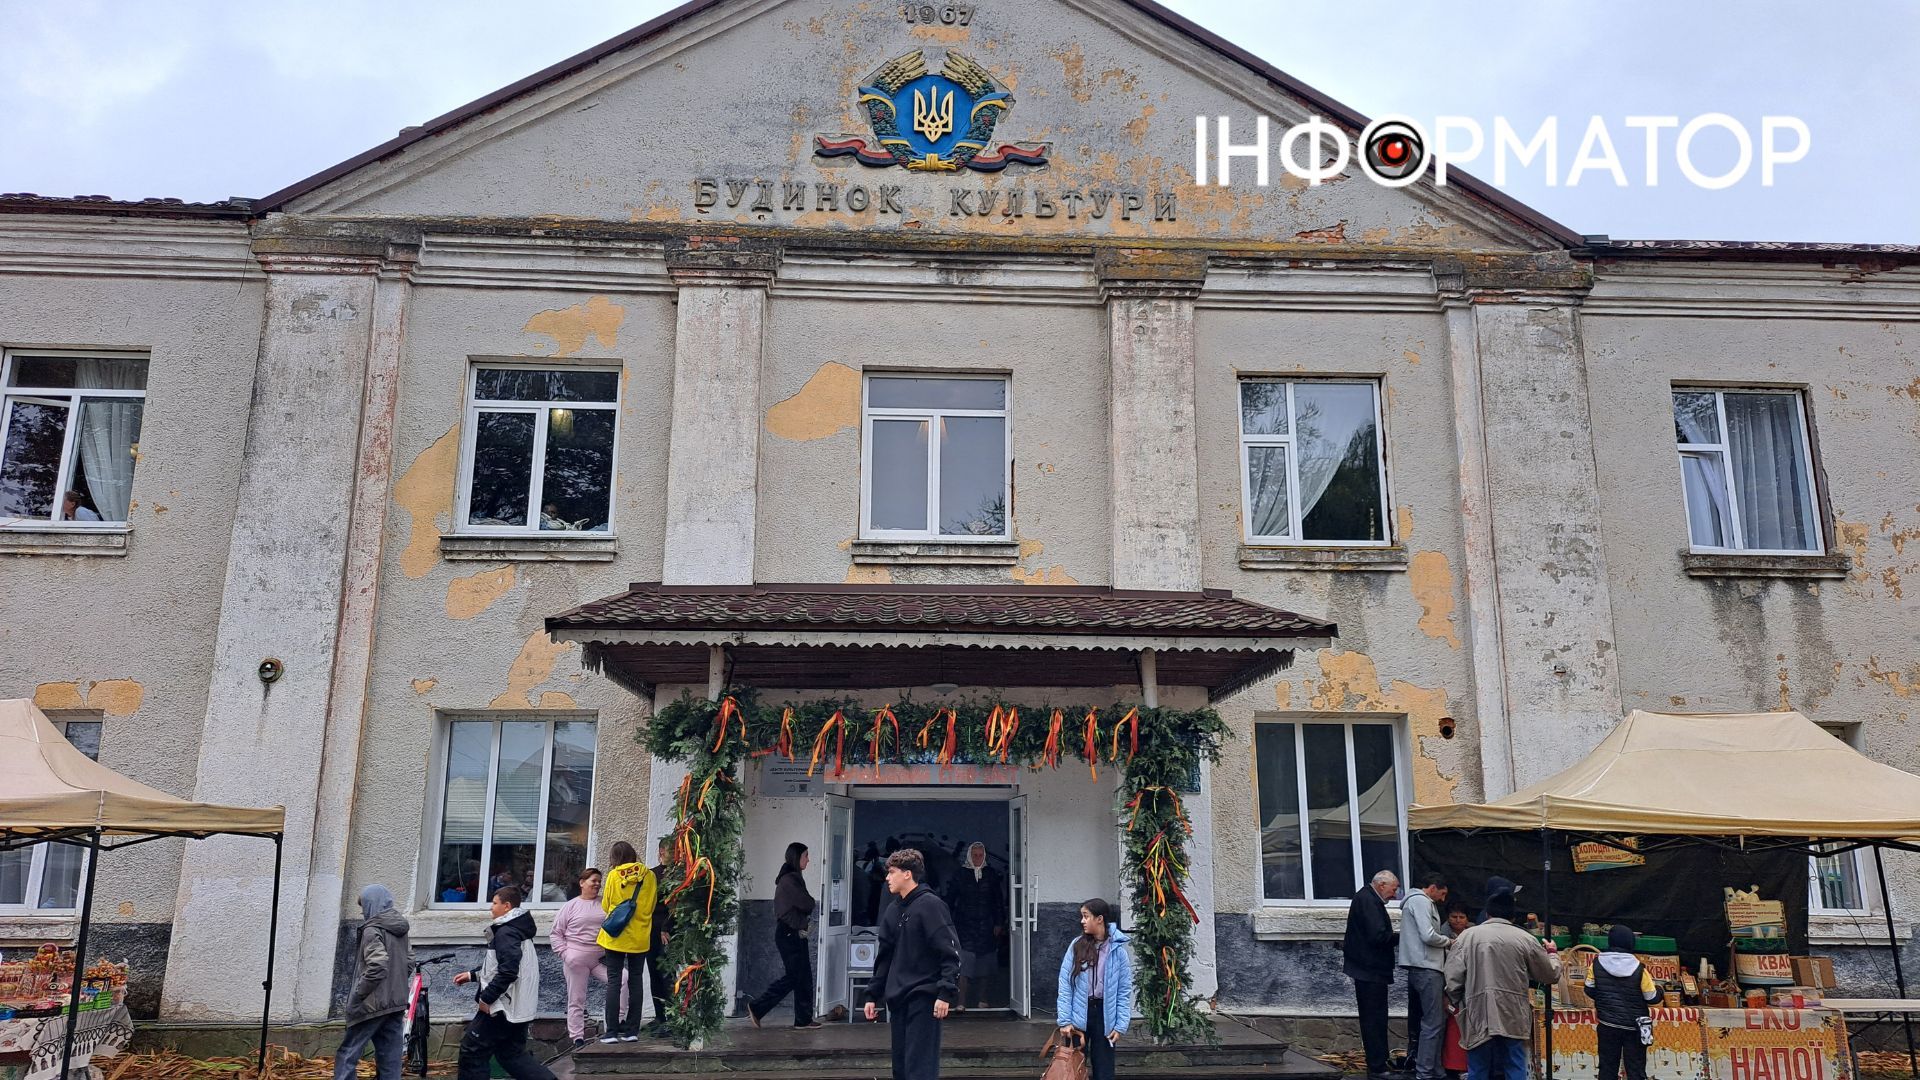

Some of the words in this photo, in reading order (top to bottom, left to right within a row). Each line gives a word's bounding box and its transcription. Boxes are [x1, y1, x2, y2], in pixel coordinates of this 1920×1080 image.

[904, 5, 976, 26] 1967
[694, 178, 903, 214] БУДИНОК
[950, 188, 1178, 221] КУЛЬТУРИ
[1745, 1008, 1801, 1030] ЕКО
[1730, 1040, 1824, 1080] НАПОЇ
